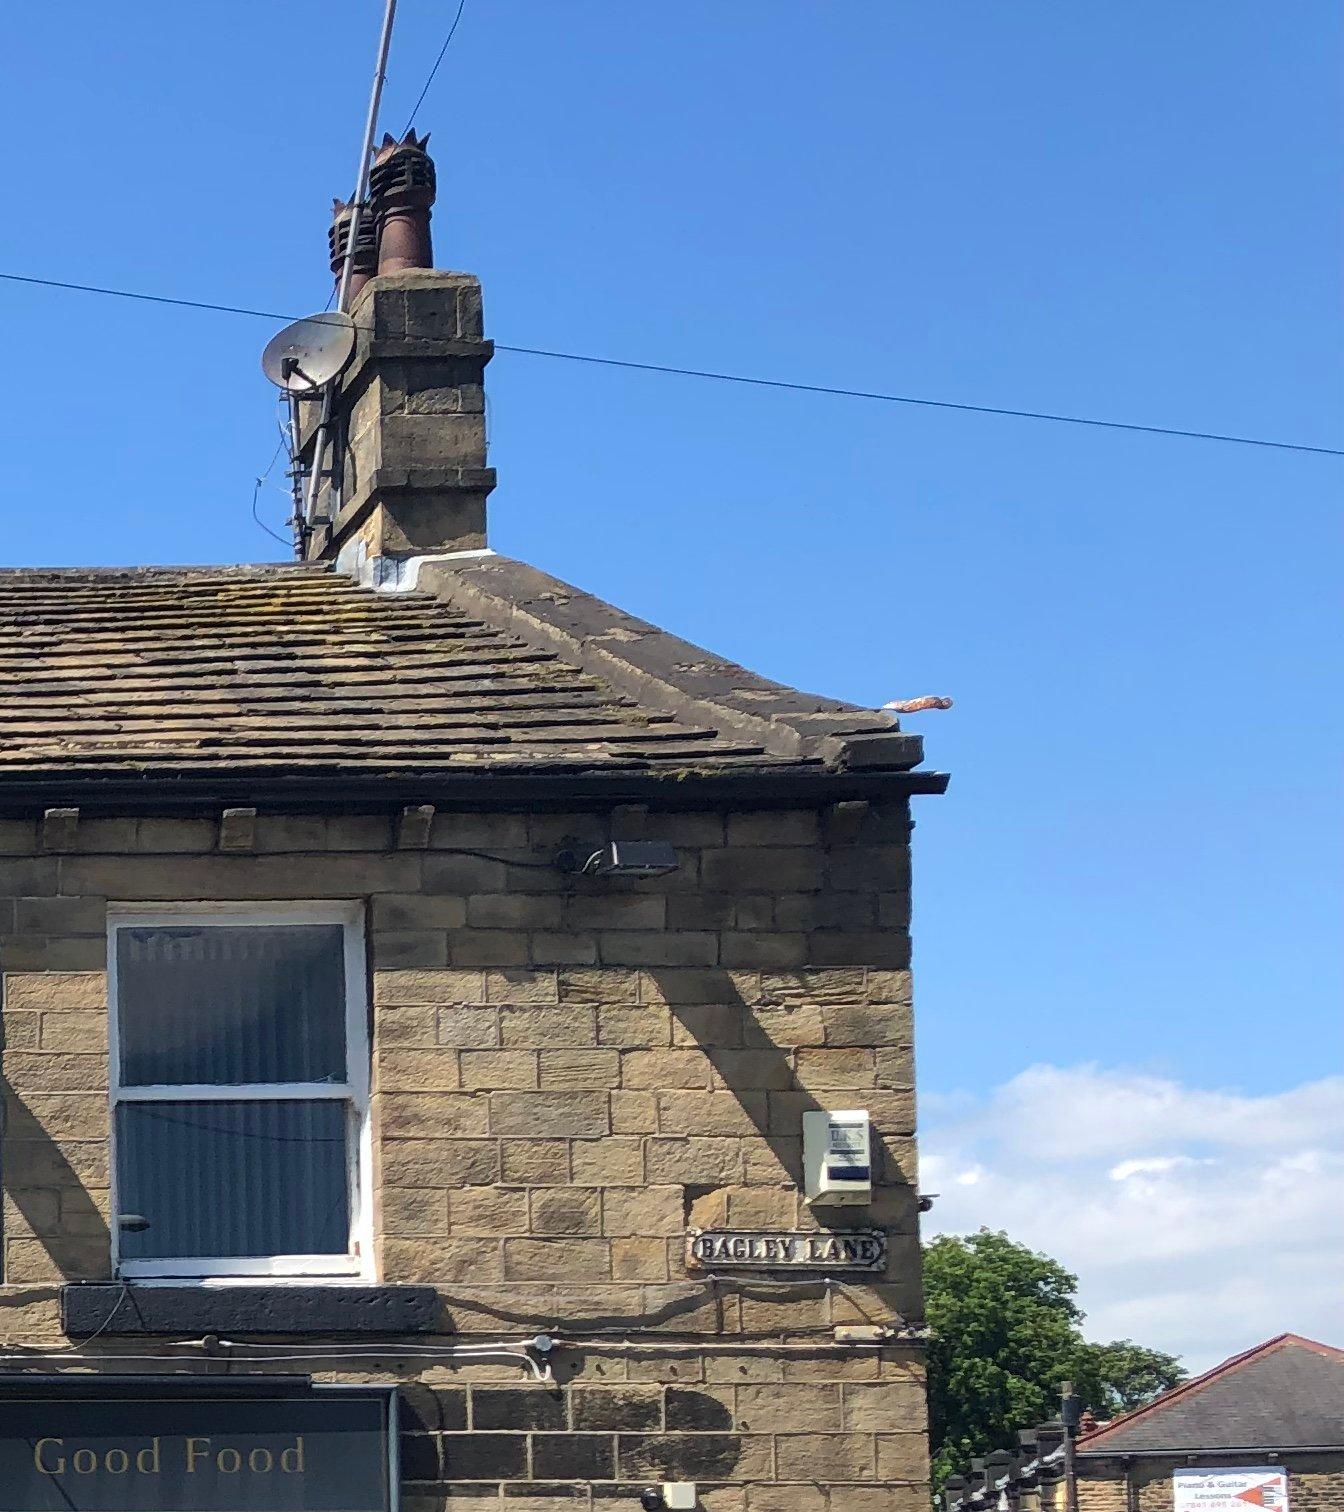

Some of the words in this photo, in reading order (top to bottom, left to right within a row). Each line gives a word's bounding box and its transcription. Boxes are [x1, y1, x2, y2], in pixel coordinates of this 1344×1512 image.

[699, 1238, 793, 1259] BAGLEY
[805, 1238, 877, 1260] LANE
[33, 1436, 161, 1475] Good
[185, 1436, 306, 1474] Food
